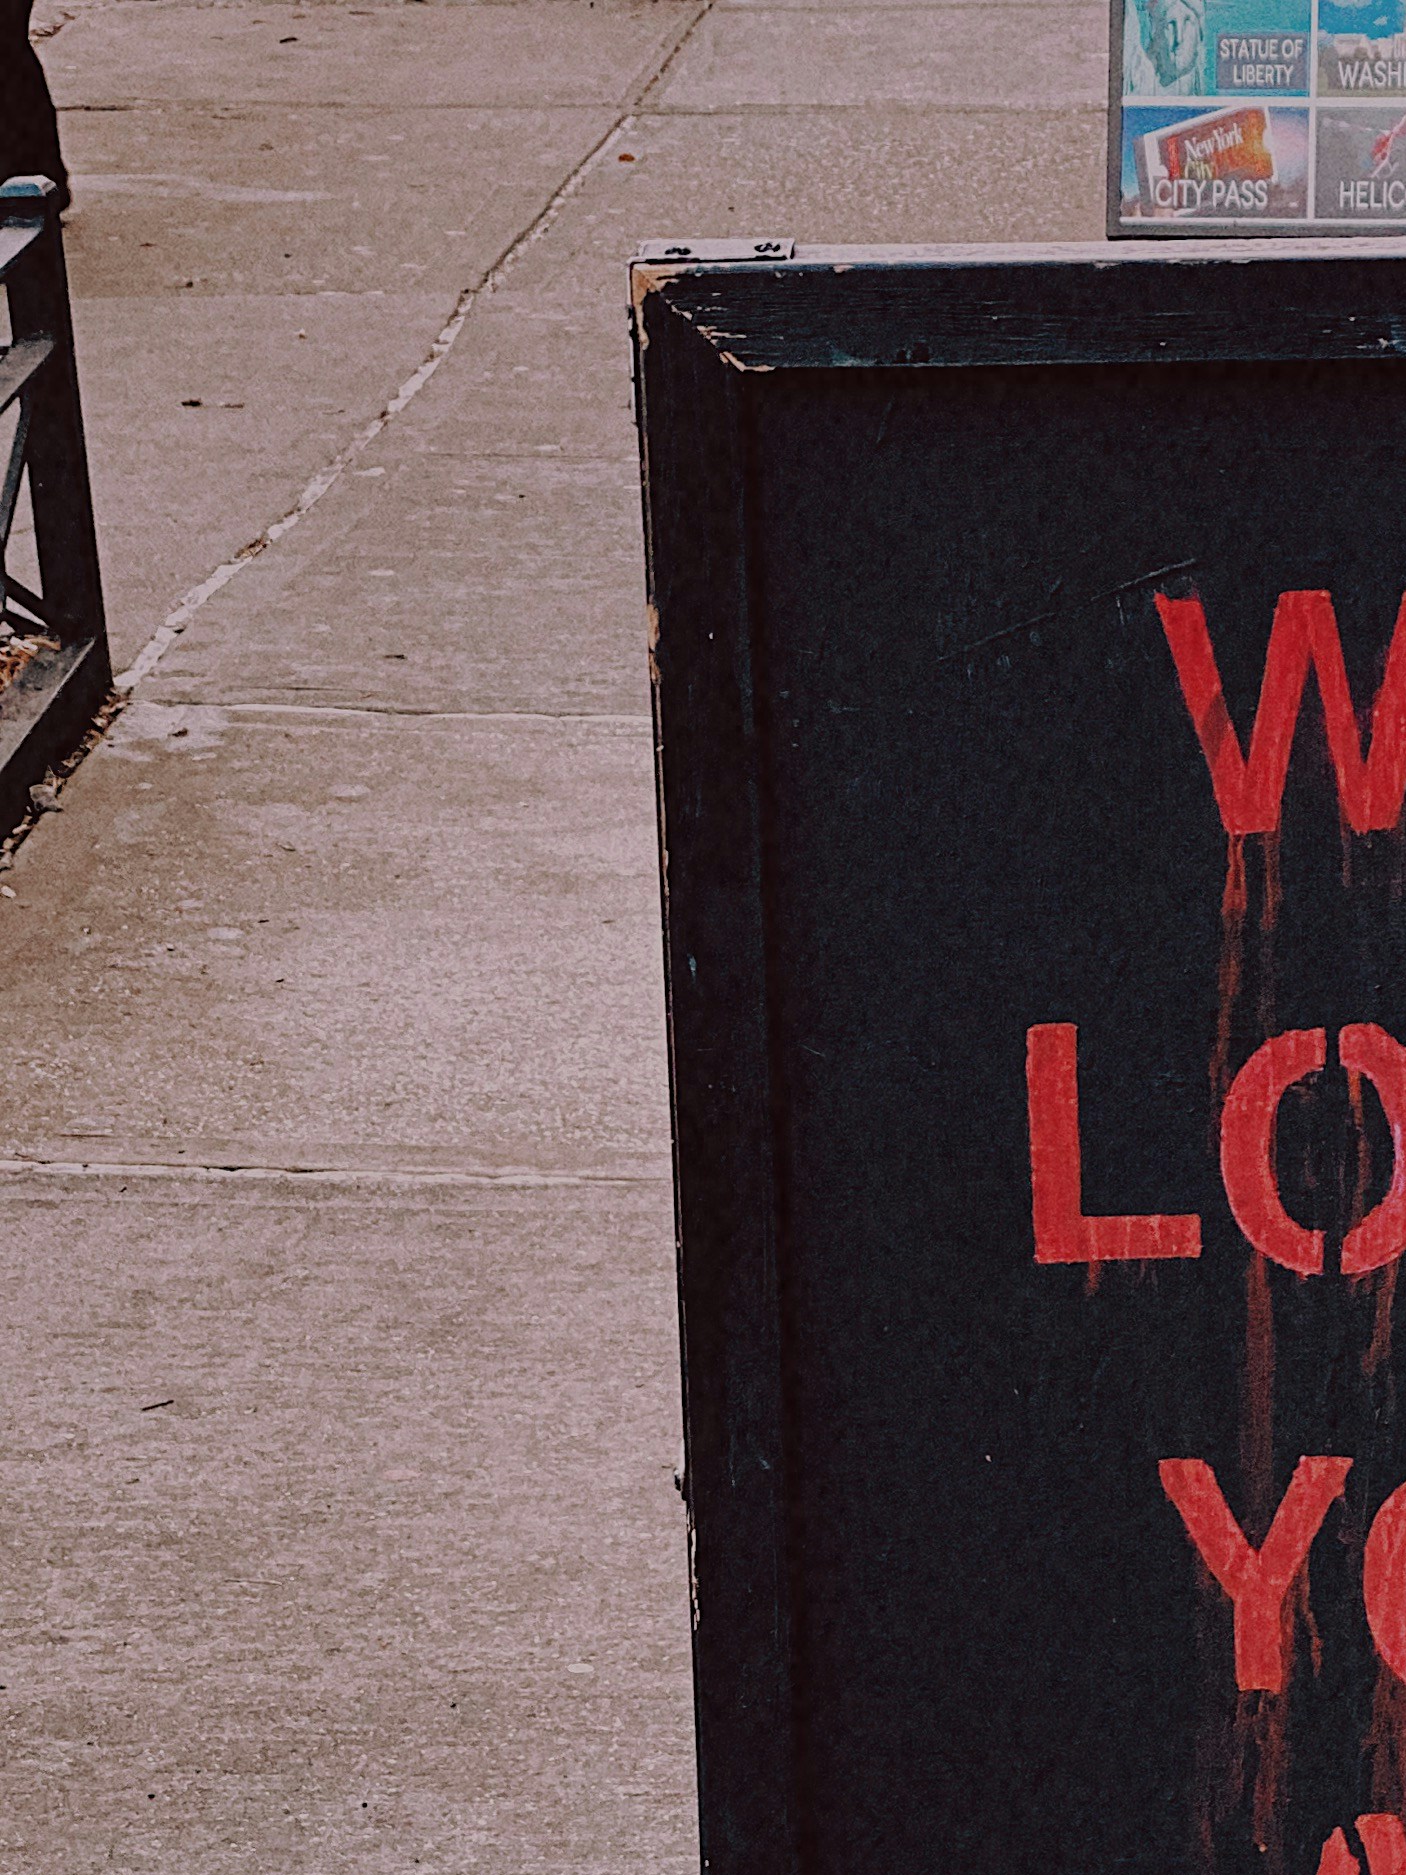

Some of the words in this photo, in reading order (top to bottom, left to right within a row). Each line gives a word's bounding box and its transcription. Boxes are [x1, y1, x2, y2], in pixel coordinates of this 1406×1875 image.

[1220, 38, 1278, 60] STATUE
[1281, 39, 1303, 60] OF
[1232, 64, 1294, 86] LIBERTY
[1184, 136, 1215, 160] New
[1212, 122, 1244, 152] York
[1155, 179, 1206, 209] CITY
[1212, 179, 1268, 209] PASS
